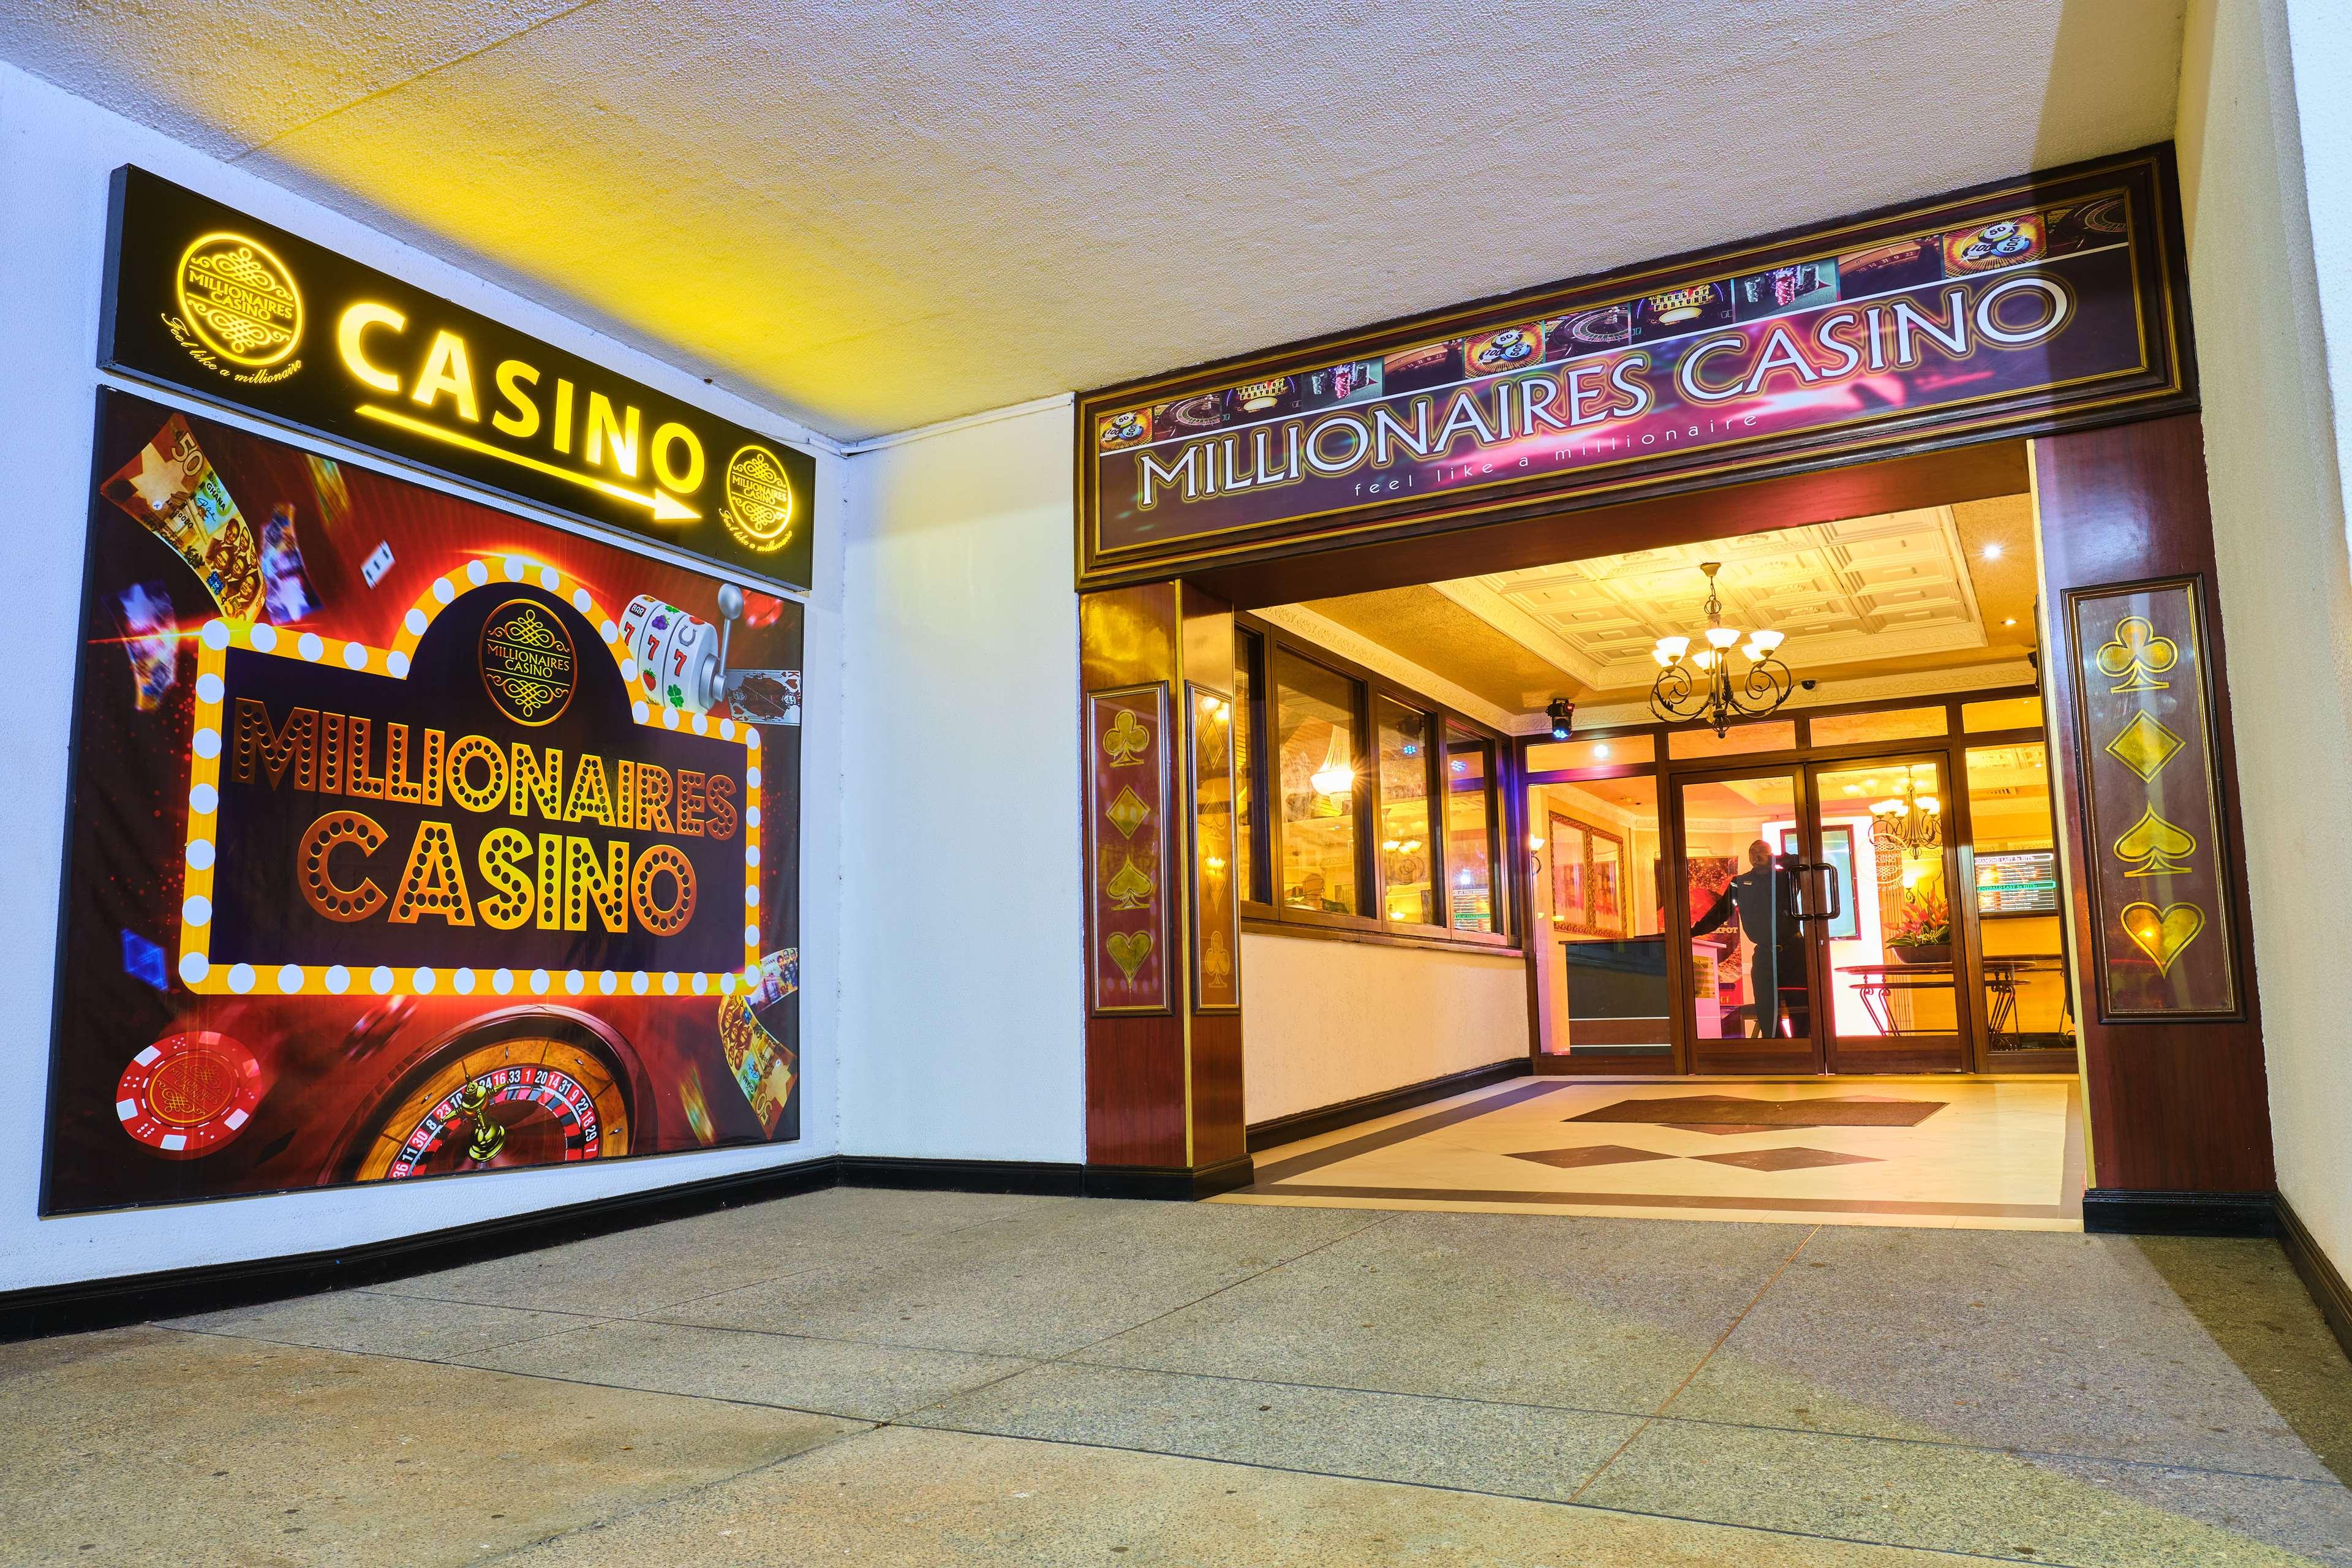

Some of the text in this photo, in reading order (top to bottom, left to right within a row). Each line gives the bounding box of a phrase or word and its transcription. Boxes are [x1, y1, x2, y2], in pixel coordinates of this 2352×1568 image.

[189, 270, 293, 319] MILLIONAIRES
[211, 291, 271, 321] CASINO
[160, 312, 198, 348] Feel
[189, 350, 217, 370] like
[234, 360, 301, 384] millionaire
[337, 303, 706, 494] CASINO
[1140, 278, 2068, 505] MILLIONAIRES CASINO
[1355, 412, 1756, 496] feel like a millionaire
[205, 481, 226, 512] GHANA
[733, 475, 786, 502] MILLIONAIRES
[744, 488, 775, 505] CASINO
[631, 604, 644, 616] BAR
[488, 644, 570, 671] MILLIONAIRES
[624, 621, 687, 677] 7 7 7
[505, 659, 552, 678] CASINO
[231, 696, 737, 841] MILLIONAIRES
[296, 810, 697, 937] CASINO
[494, 1072, 506, 1085] 16
[508, 1070, 521, 1084] 33
[526, 1070, 531, 1082] 1
[535, 1071, 548, 1085] 20
[548, 1074, 561, 1089] 14
[175, 1080, 204, 1102] CASINO
[559, 1080, 572, 1095] 31
[570, 1089, 580, 1102] 9
[450, 1093, 463, 1109] 10
[575, 1098, 589, 1115] 22
[436, 1104, 452, 1120] 23
[582, 1110, 595, 1128] 18
[426, 1119, 437, 1131] 8
[585, 1125, 598, 1142] 29
[412, 1131, 428, 1148] 30
[402, 1147, 418, 1161] 11
[586, 1144, 597, 1153] 7
[393, 1163, 409, 1178] 36
